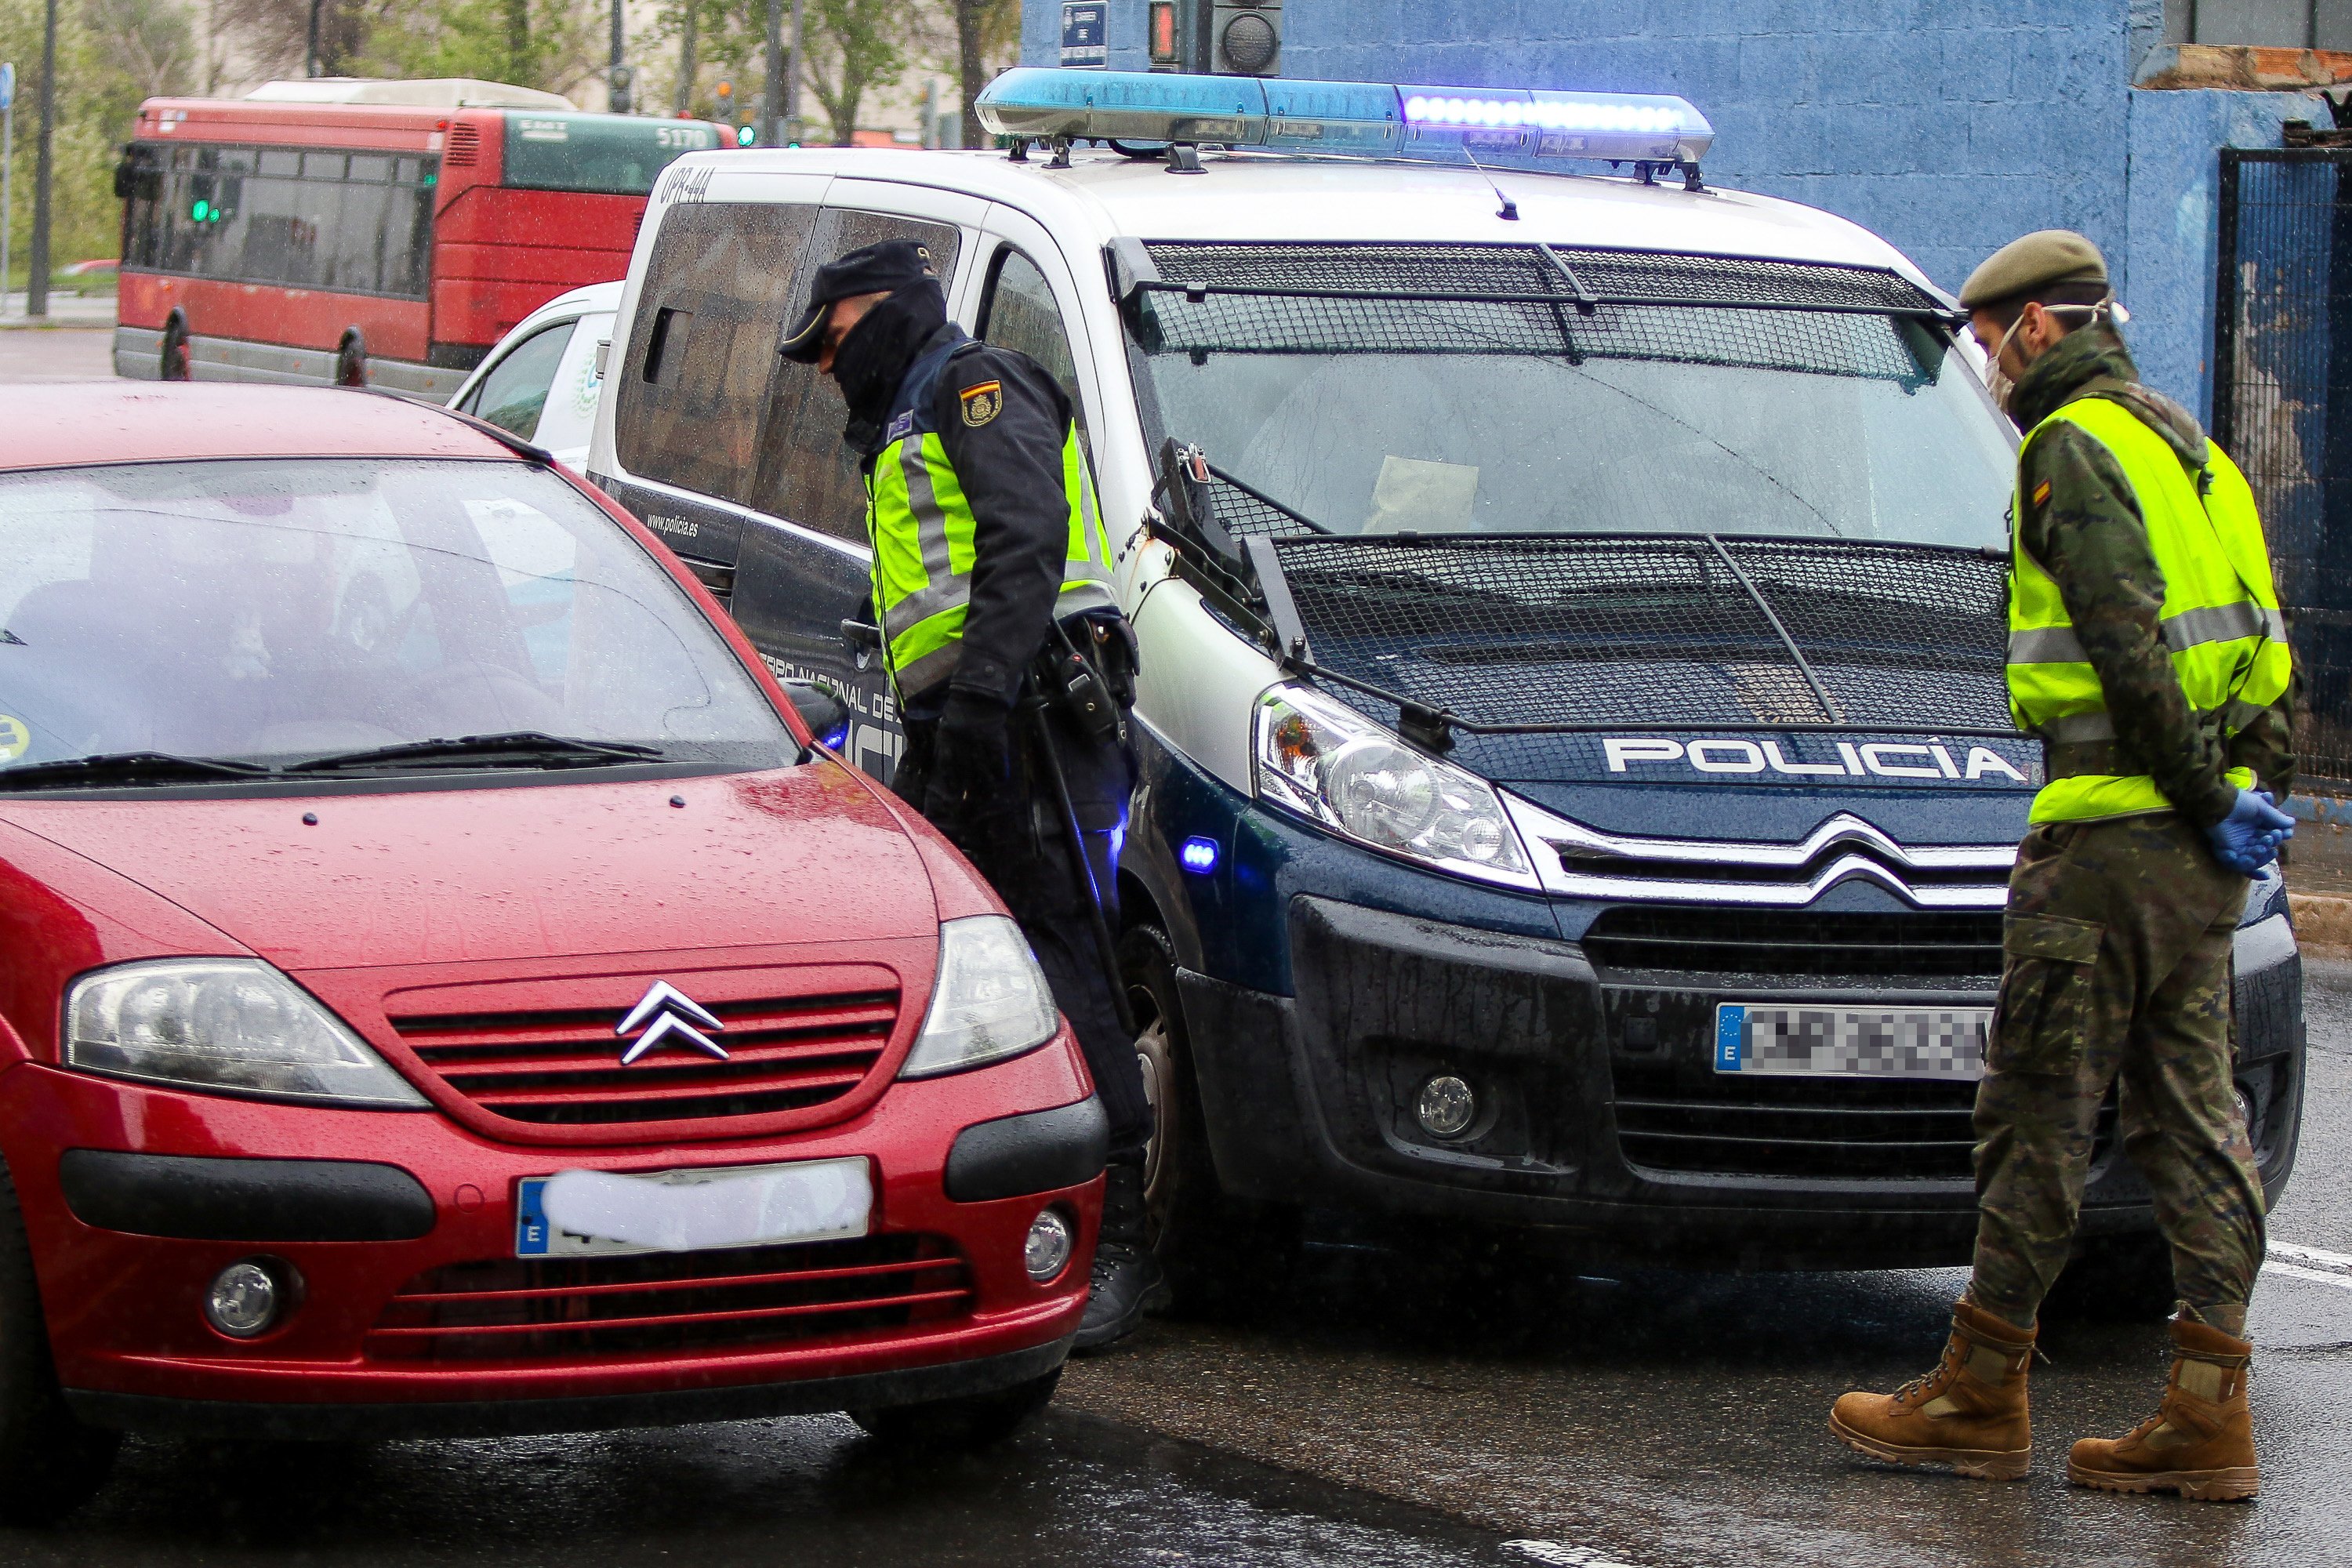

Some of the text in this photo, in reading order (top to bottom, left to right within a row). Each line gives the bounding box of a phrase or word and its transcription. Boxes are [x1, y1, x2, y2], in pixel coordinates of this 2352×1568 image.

[656, 127, 707, 147] 5170
[647, 514, 699, 538] www.policia.es
[873, 692, 895, 722] DE
[1602, 735, 2029, 782] POLICÍA
[1724, 1045, 1737, 1061] E
[527, 1225, 541, 1243] E
